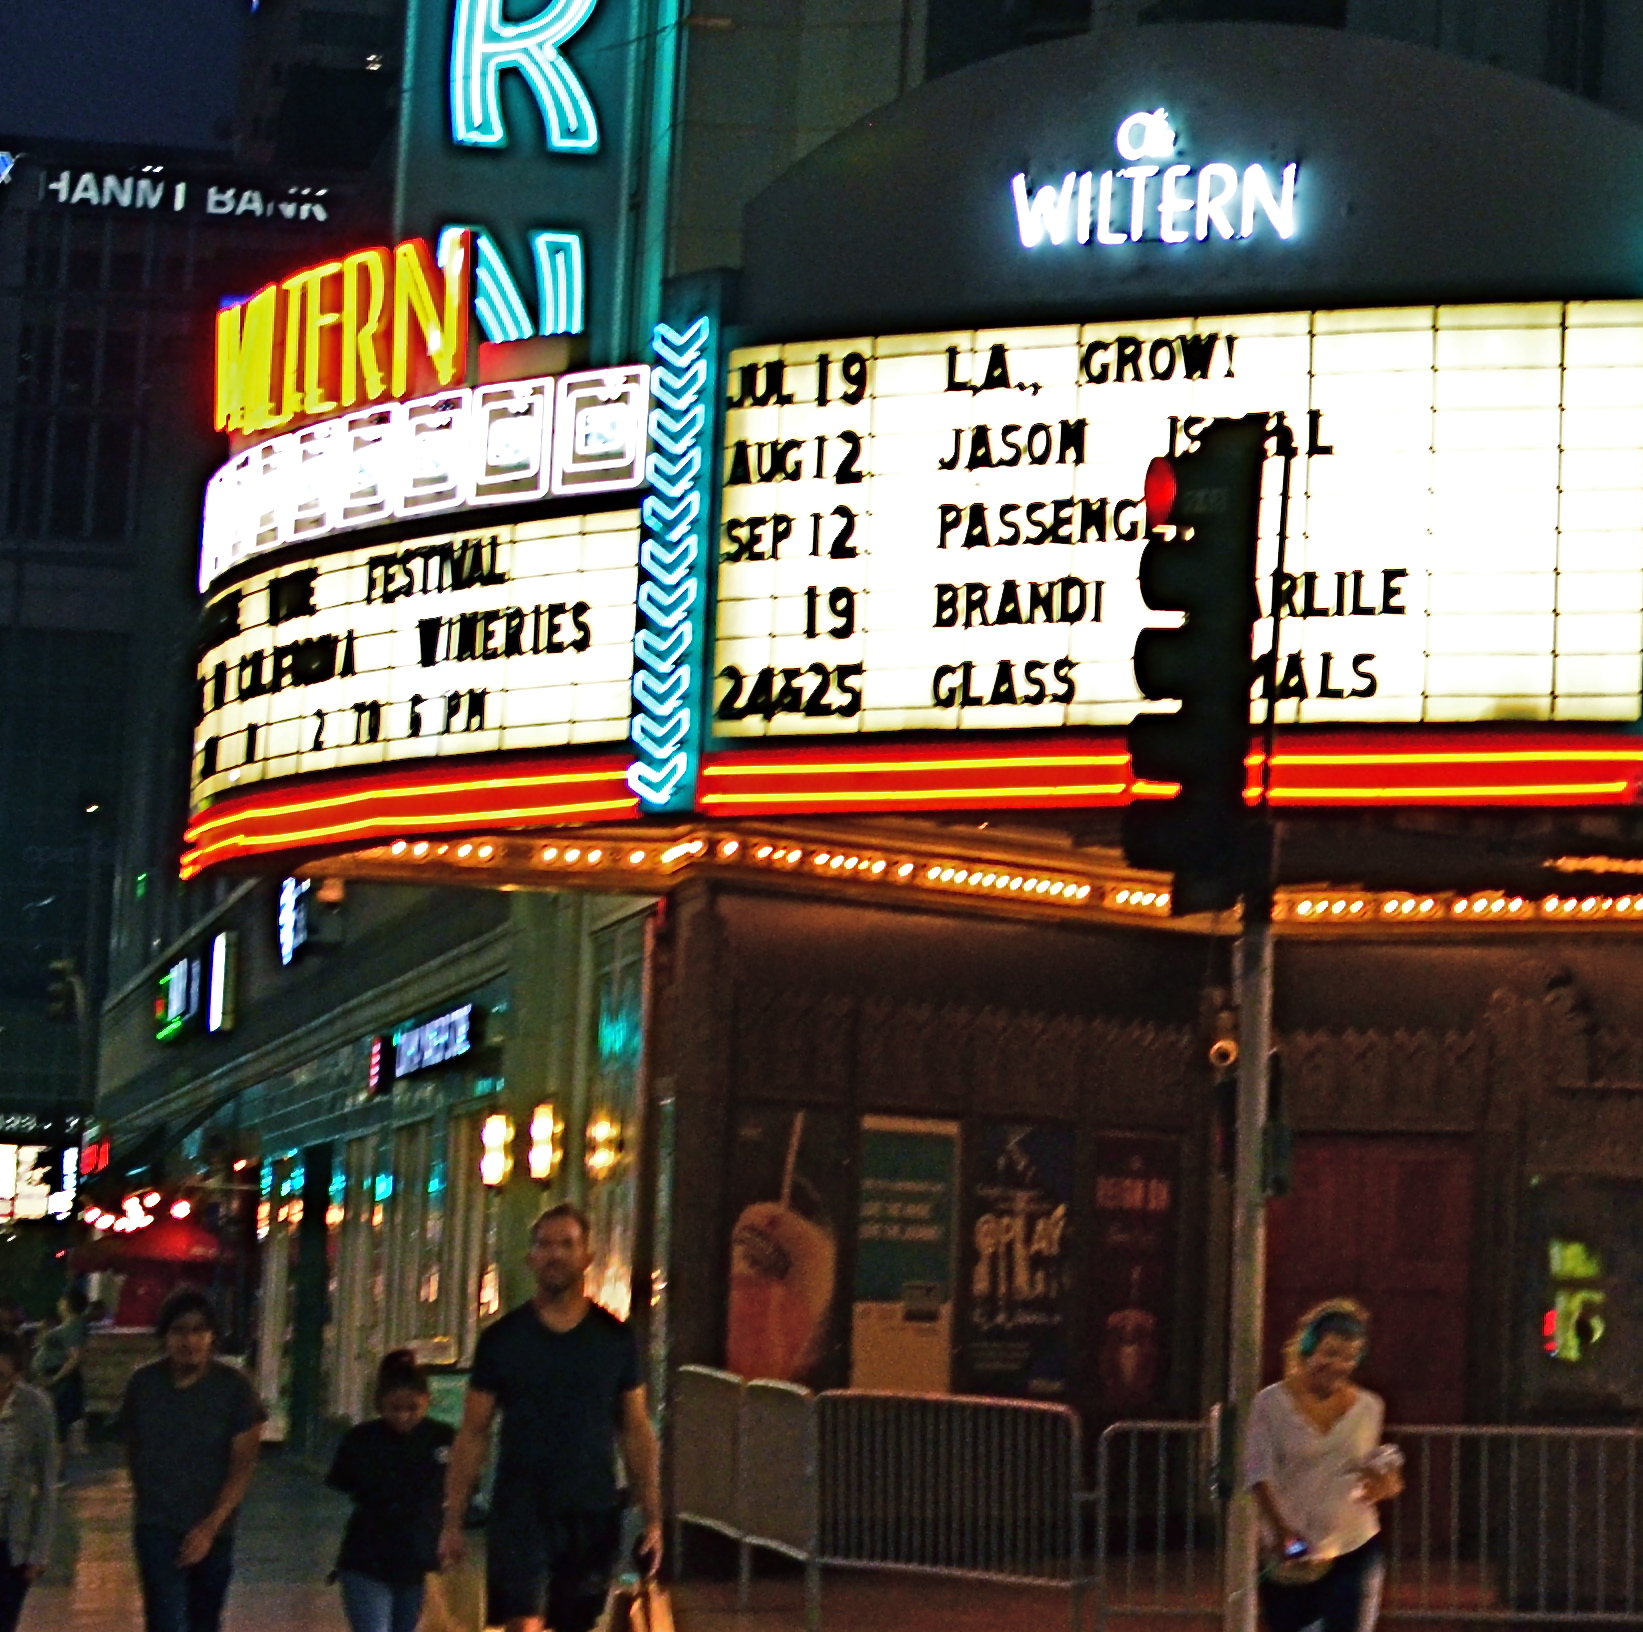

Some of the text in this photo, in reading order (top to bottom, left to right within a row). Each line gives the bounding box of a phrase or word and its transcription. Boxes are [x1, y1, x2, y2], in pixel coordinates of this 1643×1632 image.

[1012, 162, 1297, 248] WILTERN
[214, 229, 471, 435] WILTERN
[727, 359, 794, 408] JUL
[816, 351, 868, 407] 19
[1083, 332, 1236, 385] GROW!
[724, 439, 804, 486] AUG
[814, 429, 863, 485] 12
[938, 417, 1088, 471] JASON
[722, 497, 1148, 563] SEP 12 PASSENG
[417, 600, 591, 667] WINERIES
[803, 568, 1409, 639] 19 BRANDI RLILE
[932, 658, 1080, 709] GLASS
